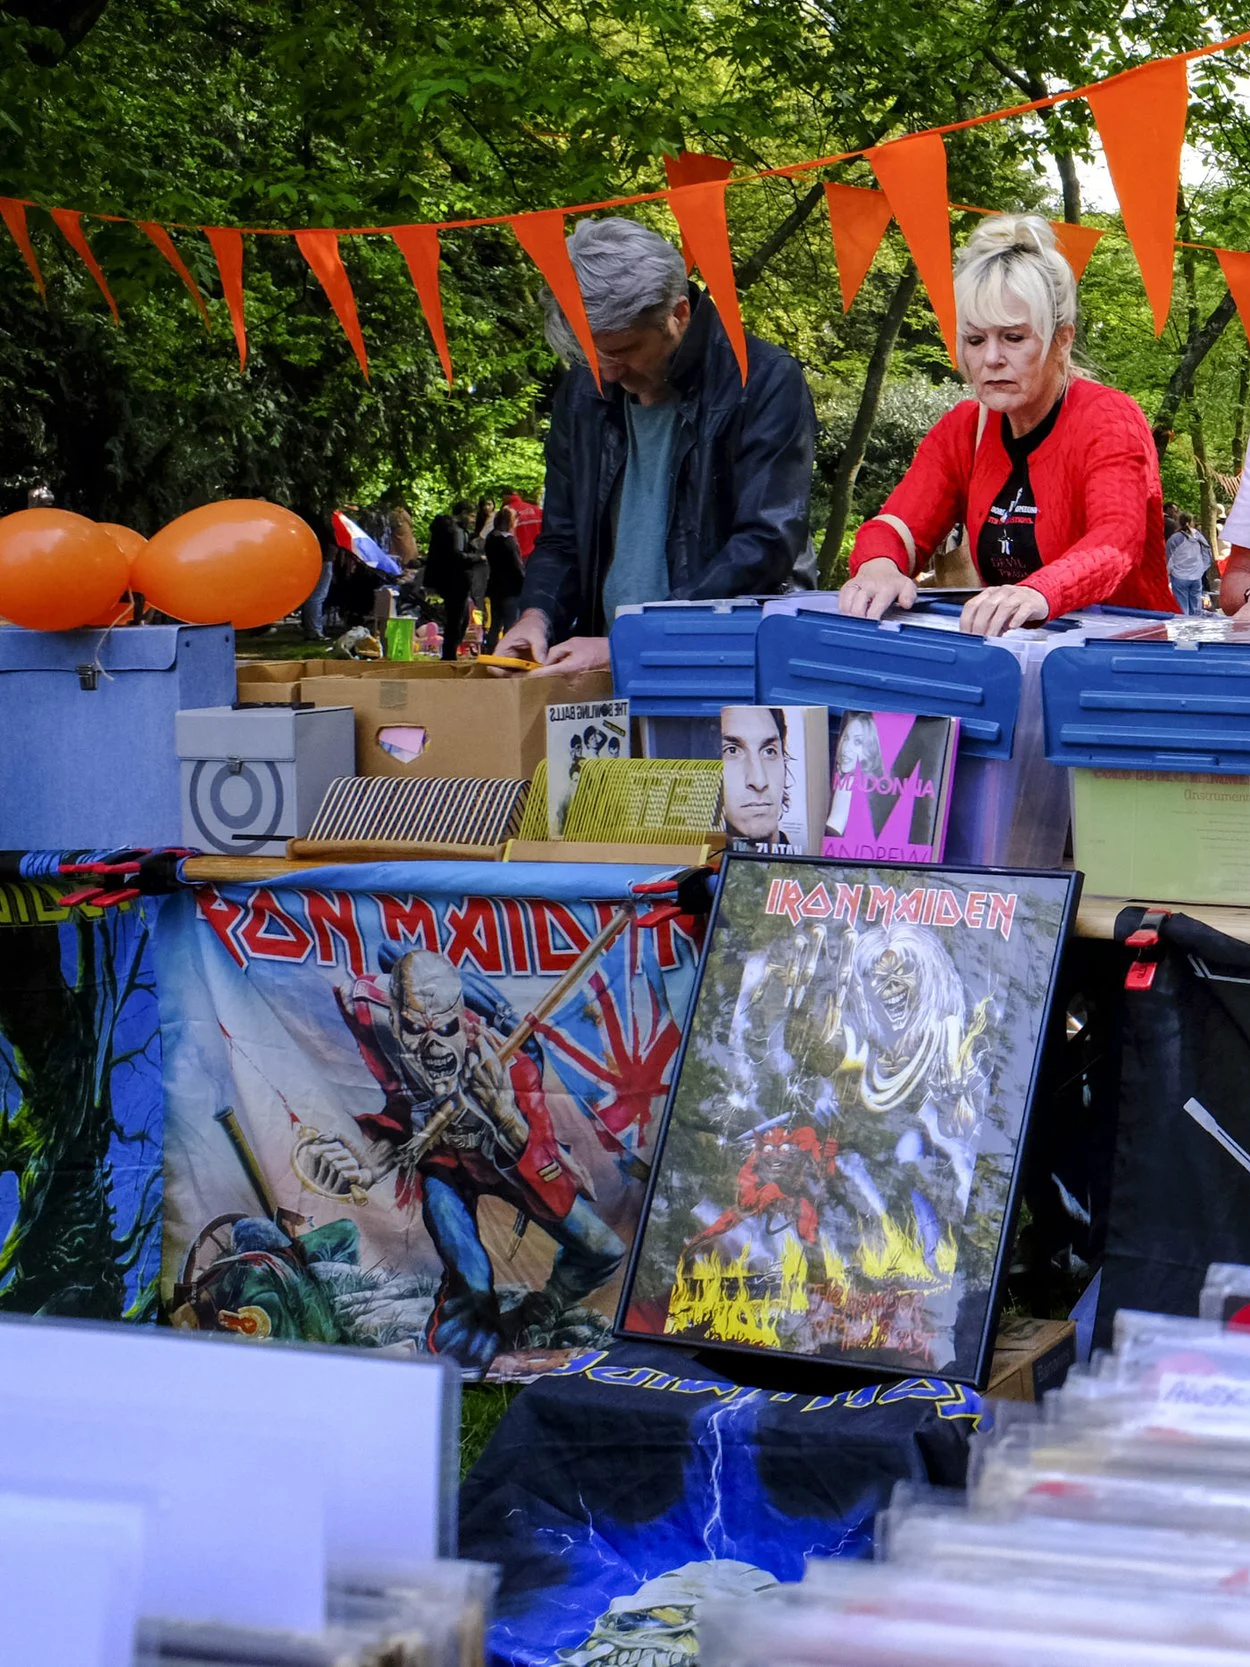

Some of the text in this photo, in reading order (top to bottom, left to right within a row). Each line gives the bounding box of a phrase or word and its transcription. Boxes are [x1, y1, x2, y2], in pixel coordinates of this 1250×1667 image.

[831, 772, 935, 799] MADONNA
[765, 878, 1018, 942] IRON MAIDEN
